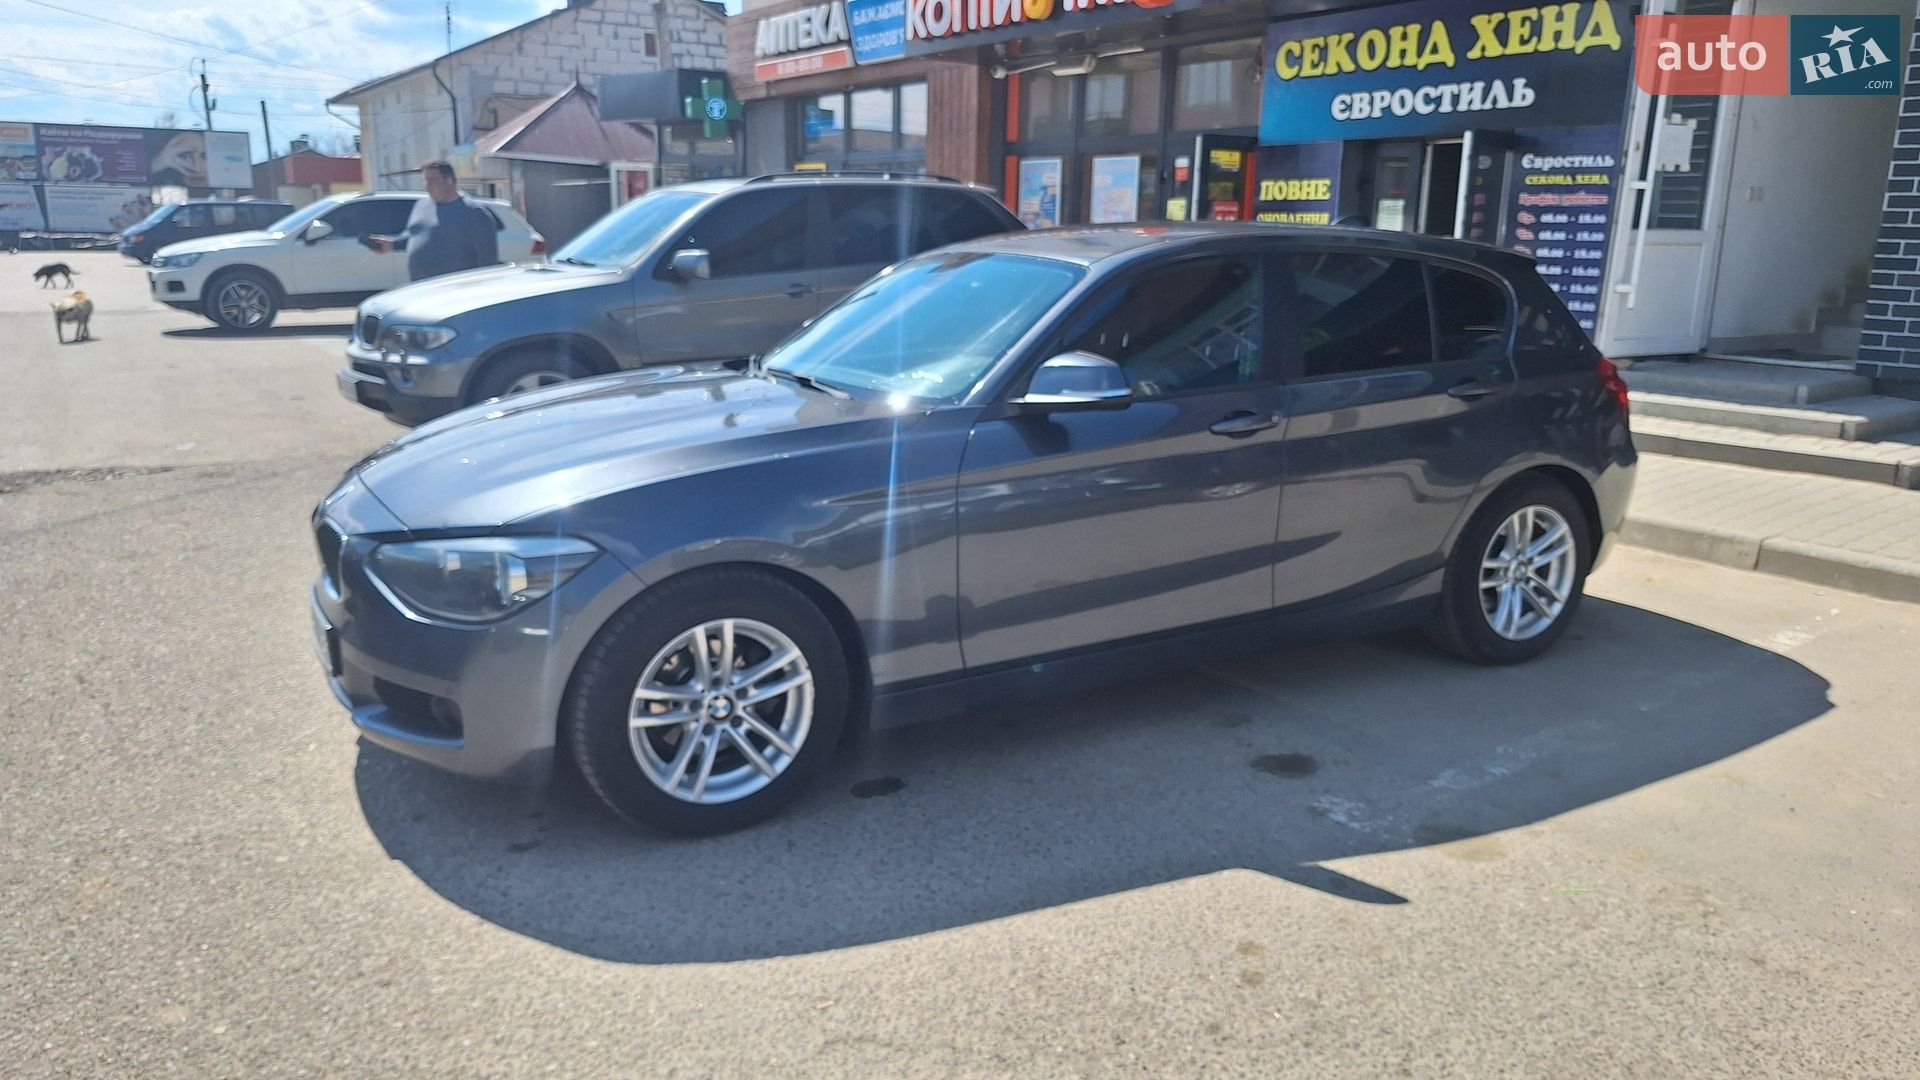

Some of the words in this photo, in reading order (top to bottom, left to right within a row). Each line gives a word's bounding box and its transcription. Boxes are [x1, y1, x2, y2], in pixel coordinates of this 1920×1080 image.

[755, 2, 849, 57] АПТЕКА
[1275, 20, 1455, 80] СЕКОНД
[1466, 0, 1621, 58] ХЕНД
[1330, 78, 1535, 120] ЄВРОСТИЛЬ
[1521, 153, 1615, 171] Євростиль
[1259, 178, 1332, 201] ПОВНЕ
[1525, 174, 1573, 185] СЕКОНД
[1575, 174, 1609, 185] ХЕНД
